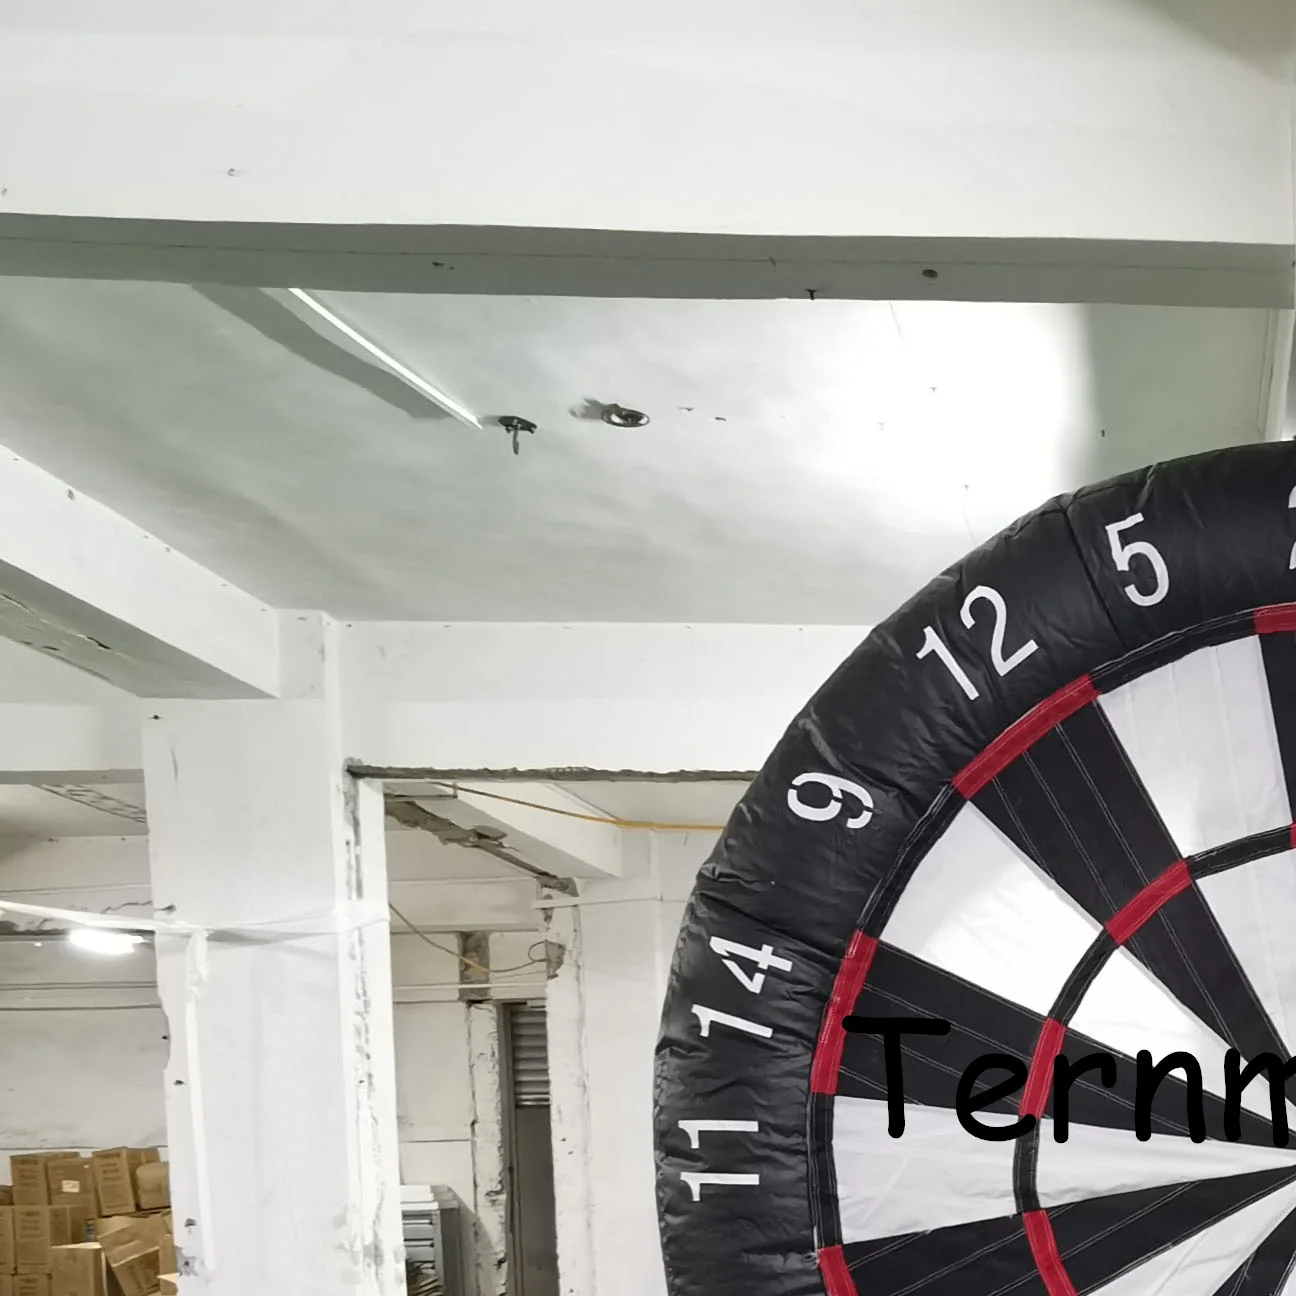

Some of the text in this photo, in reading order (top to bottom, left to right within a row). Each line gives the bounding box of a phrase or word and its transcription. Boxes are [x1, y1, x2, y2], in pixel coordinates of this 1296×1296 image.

[1105, 512, 1169, 607] 5
[915, 584, 1039, 700] 12
[787, 772, 874, 829] 9
[691, 936, 793, 1038] 14
[678, 1119, 760, 1202] 11
